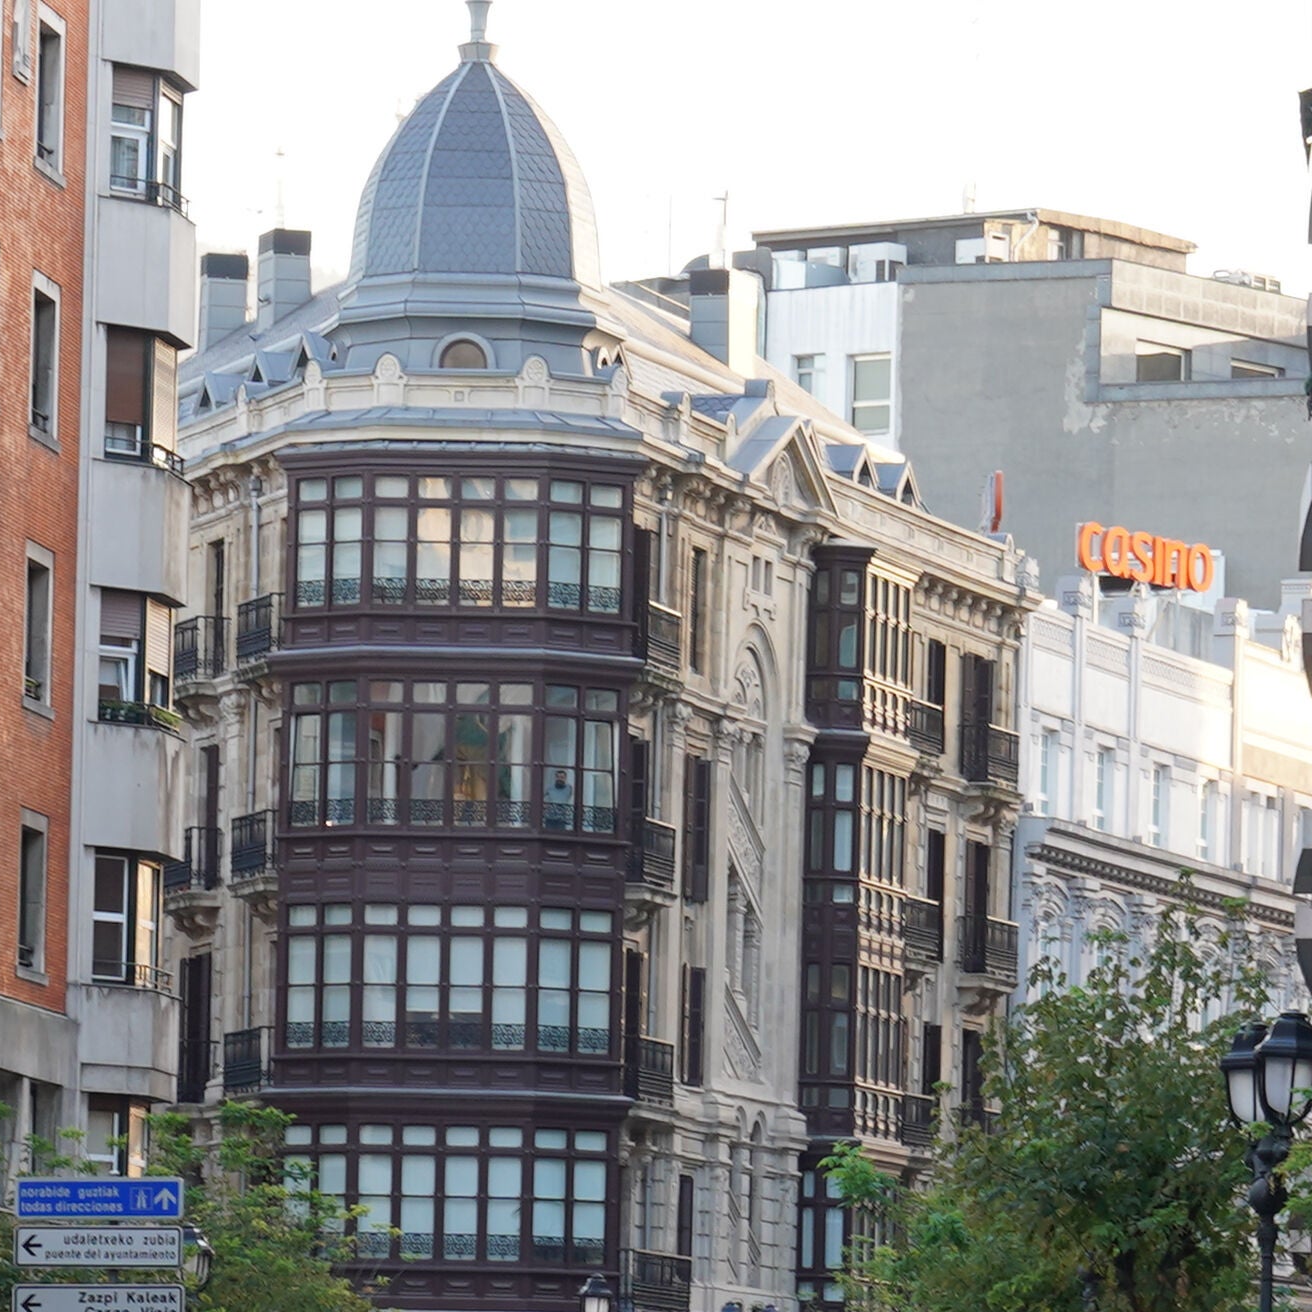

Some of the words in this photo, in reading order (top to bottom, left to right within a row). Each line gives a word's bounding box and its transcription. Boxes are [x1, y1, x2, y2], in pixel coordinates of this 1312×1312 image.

[1078, 521, 1214, 593] casino
[20, 1186, 71, 1198] norabide
[77, 1186, 120, 1200] guztiak
[20, 1201, 52, 1213] todas
[55, 1201, 123, 1213] direcciones
[63, 1233, 134, 1245] udaletxeko
[143, 1233, 176, 1245] zubia
[44, 1250, 82, 1260] puente
[84, 1249, 101, 1259] del
[103, 1249, 176, 1261] ayuntamiento
[78, 1291, 118, 1306] Zazpi
[126, 1291, 177, 1304] Kaleak
